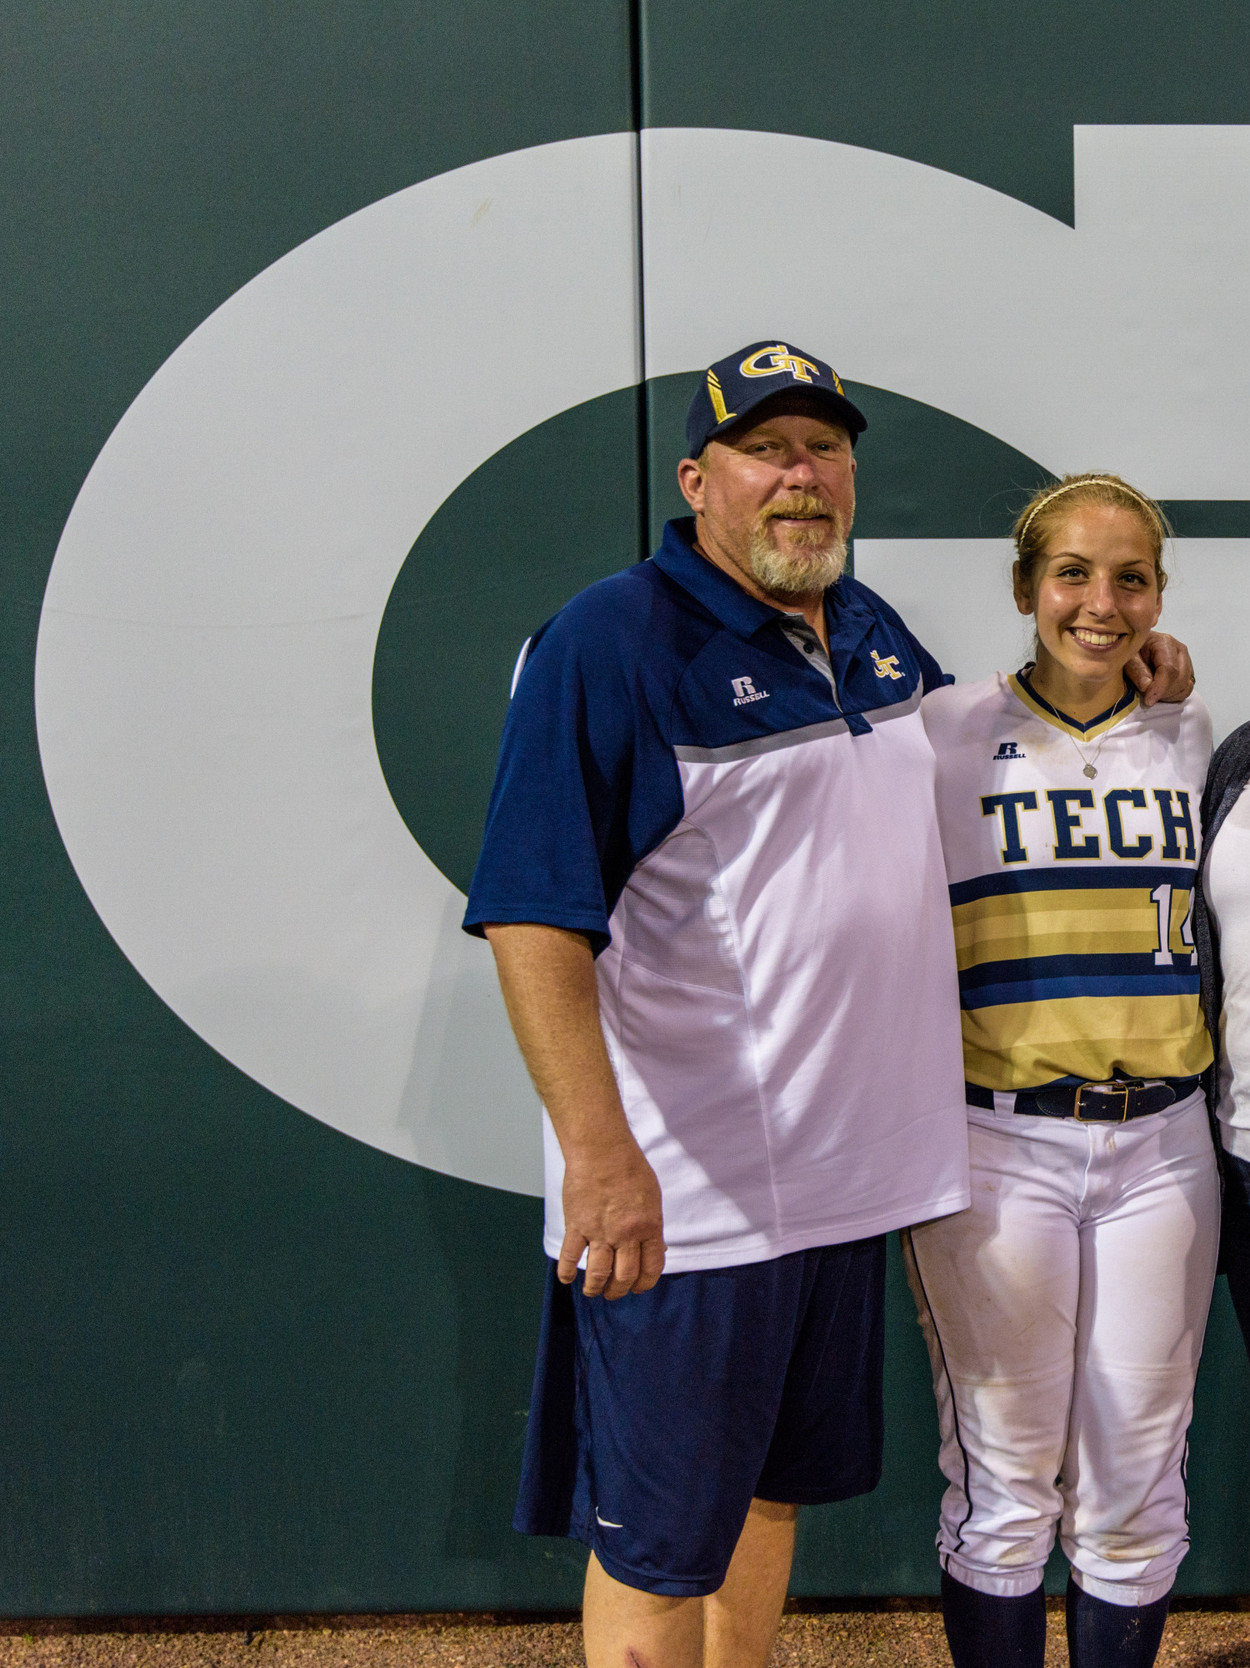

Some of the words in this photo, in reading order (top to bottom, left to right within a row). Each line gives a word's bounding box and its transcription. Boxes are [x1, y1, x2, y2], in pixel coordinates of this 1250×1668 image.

[739, 344, 820, 383] GT
[731, 676, 756, 697] R
[733, 690, 770, 706] RUSSELL
[998, 742, 1018, 755] R
[979, 787, 1197, 865] TECH
